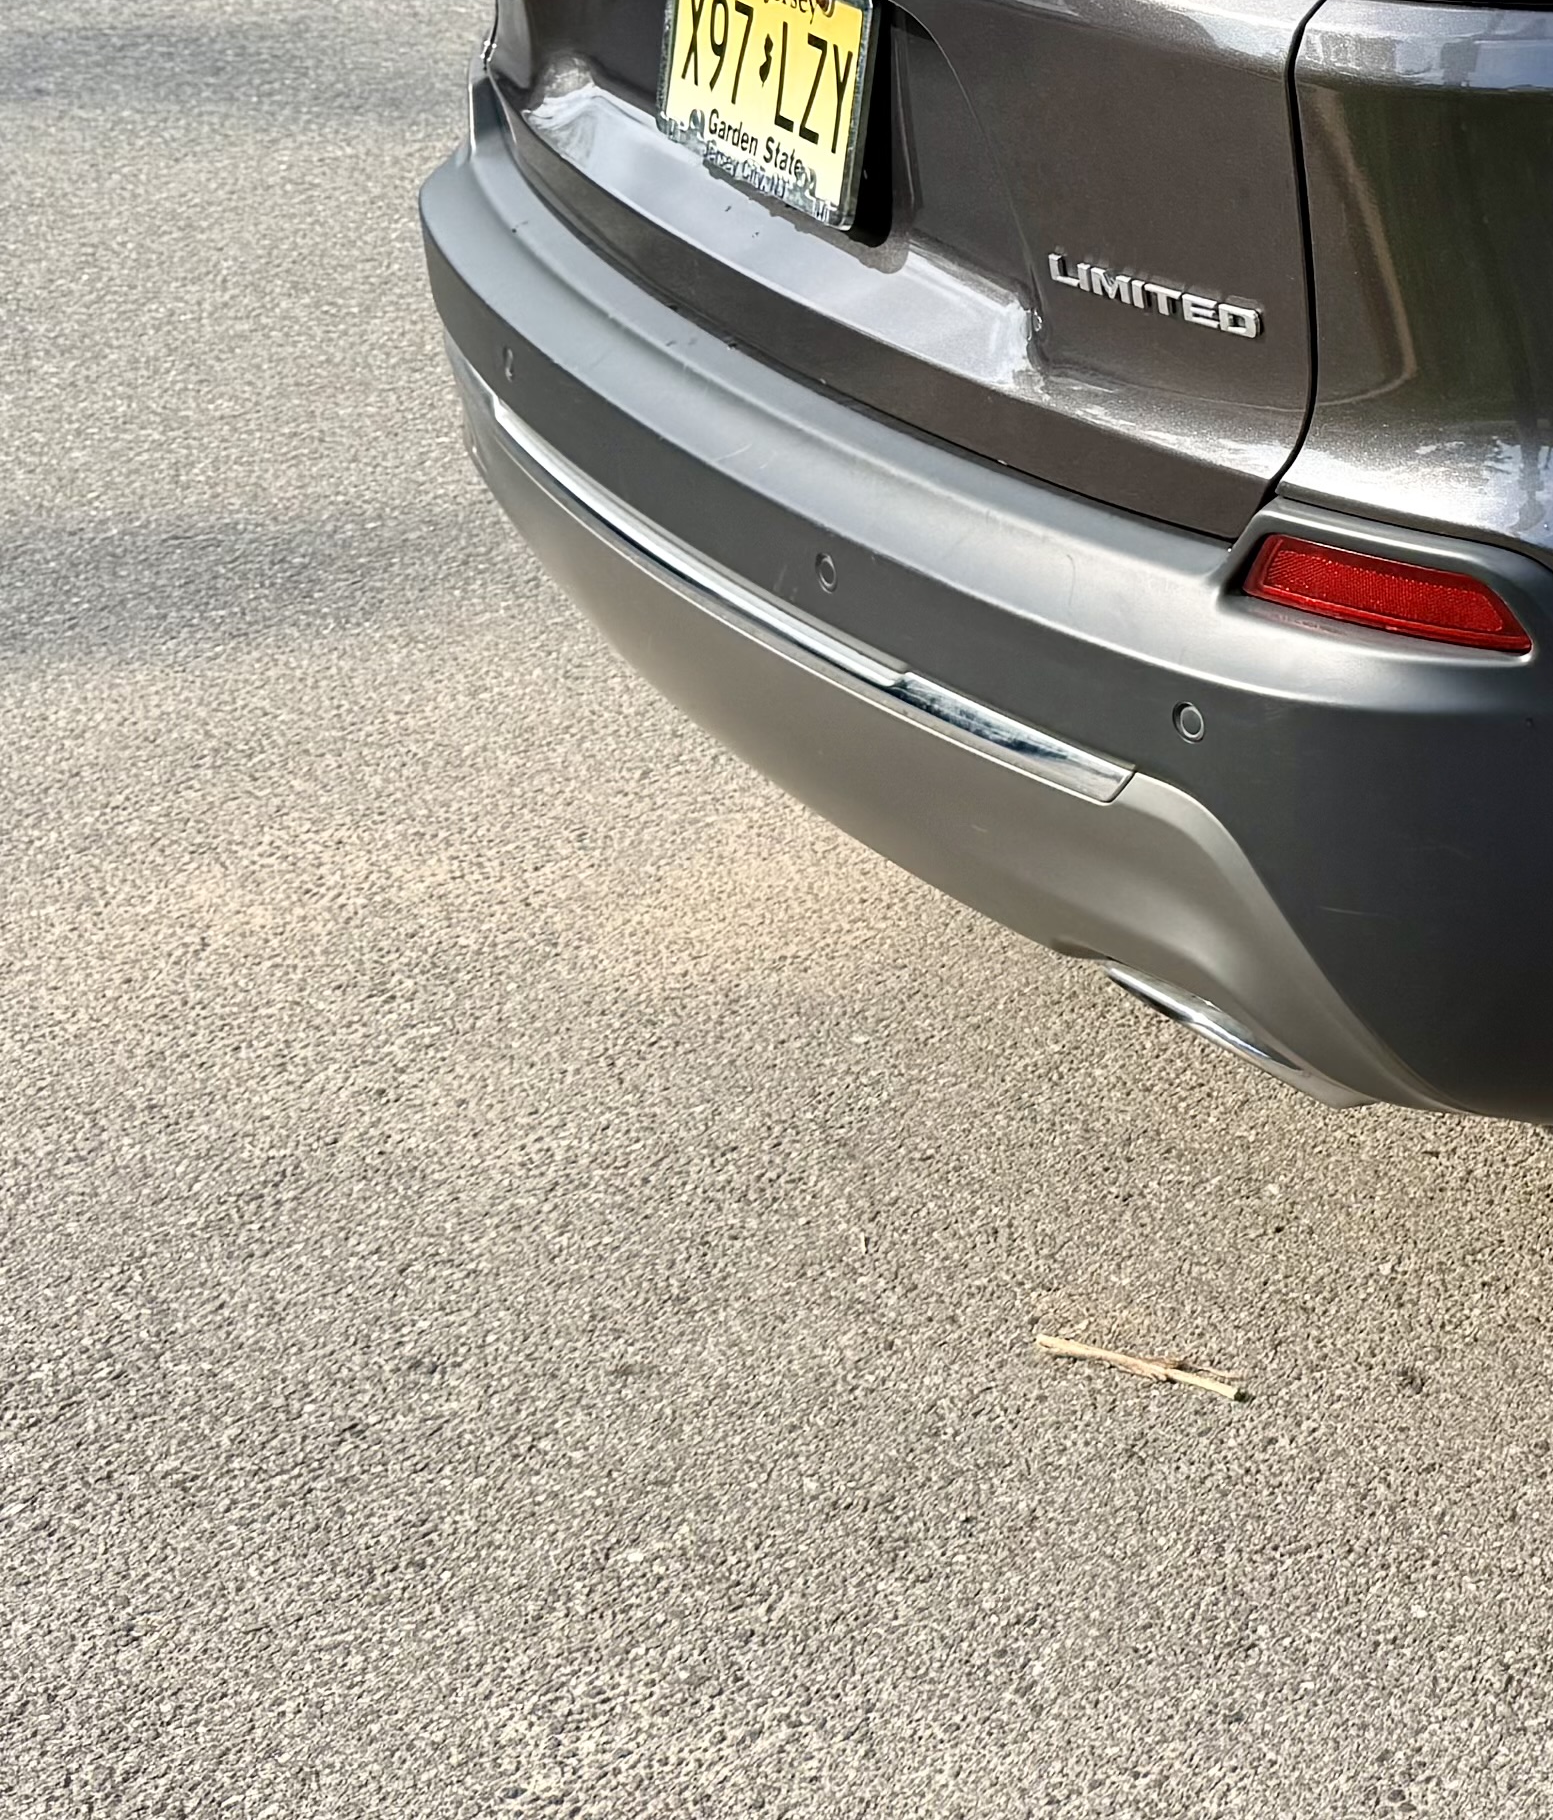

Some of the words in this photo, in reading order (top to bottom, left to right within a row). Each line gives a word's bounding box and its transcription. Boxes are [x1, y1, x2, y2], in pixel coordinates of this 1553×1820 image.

[774, 21, 853, 154] LZY
[708, 108, 758, 156] Garden
[763, 135, 803, 177] State
[1048, 253, 1261, 339] LIMITED
